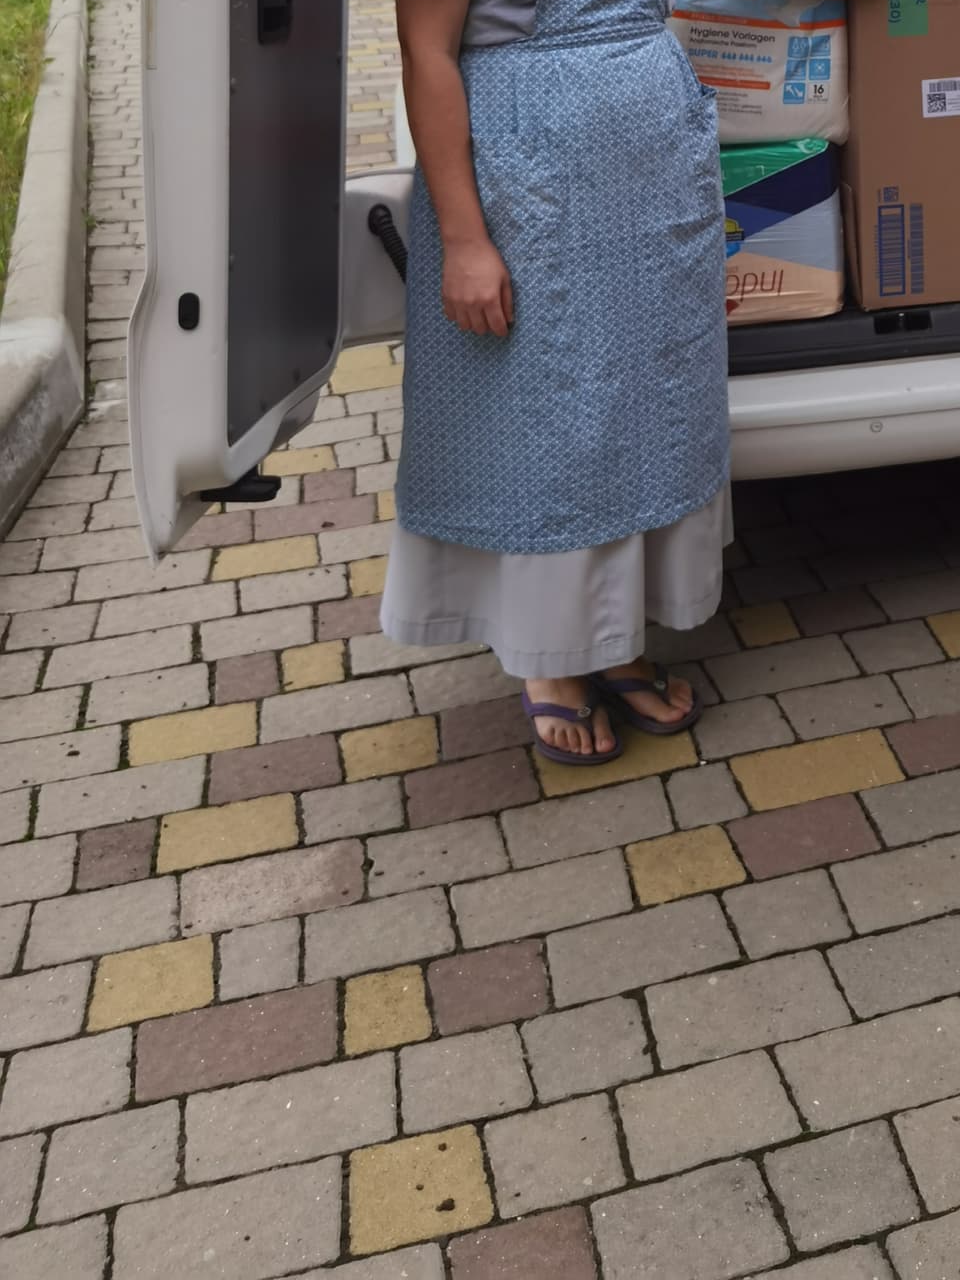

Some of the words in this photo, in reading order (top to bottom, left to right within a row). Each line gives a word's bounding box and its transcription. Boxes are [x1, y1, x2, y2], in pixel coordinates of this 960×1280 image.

[690, 26, 730, 38] Hygiene
[732, 29, 776, 43] Vorlagen
[688, 47, 718, 59] SUPER
[813, 84, 825, 94] 16
